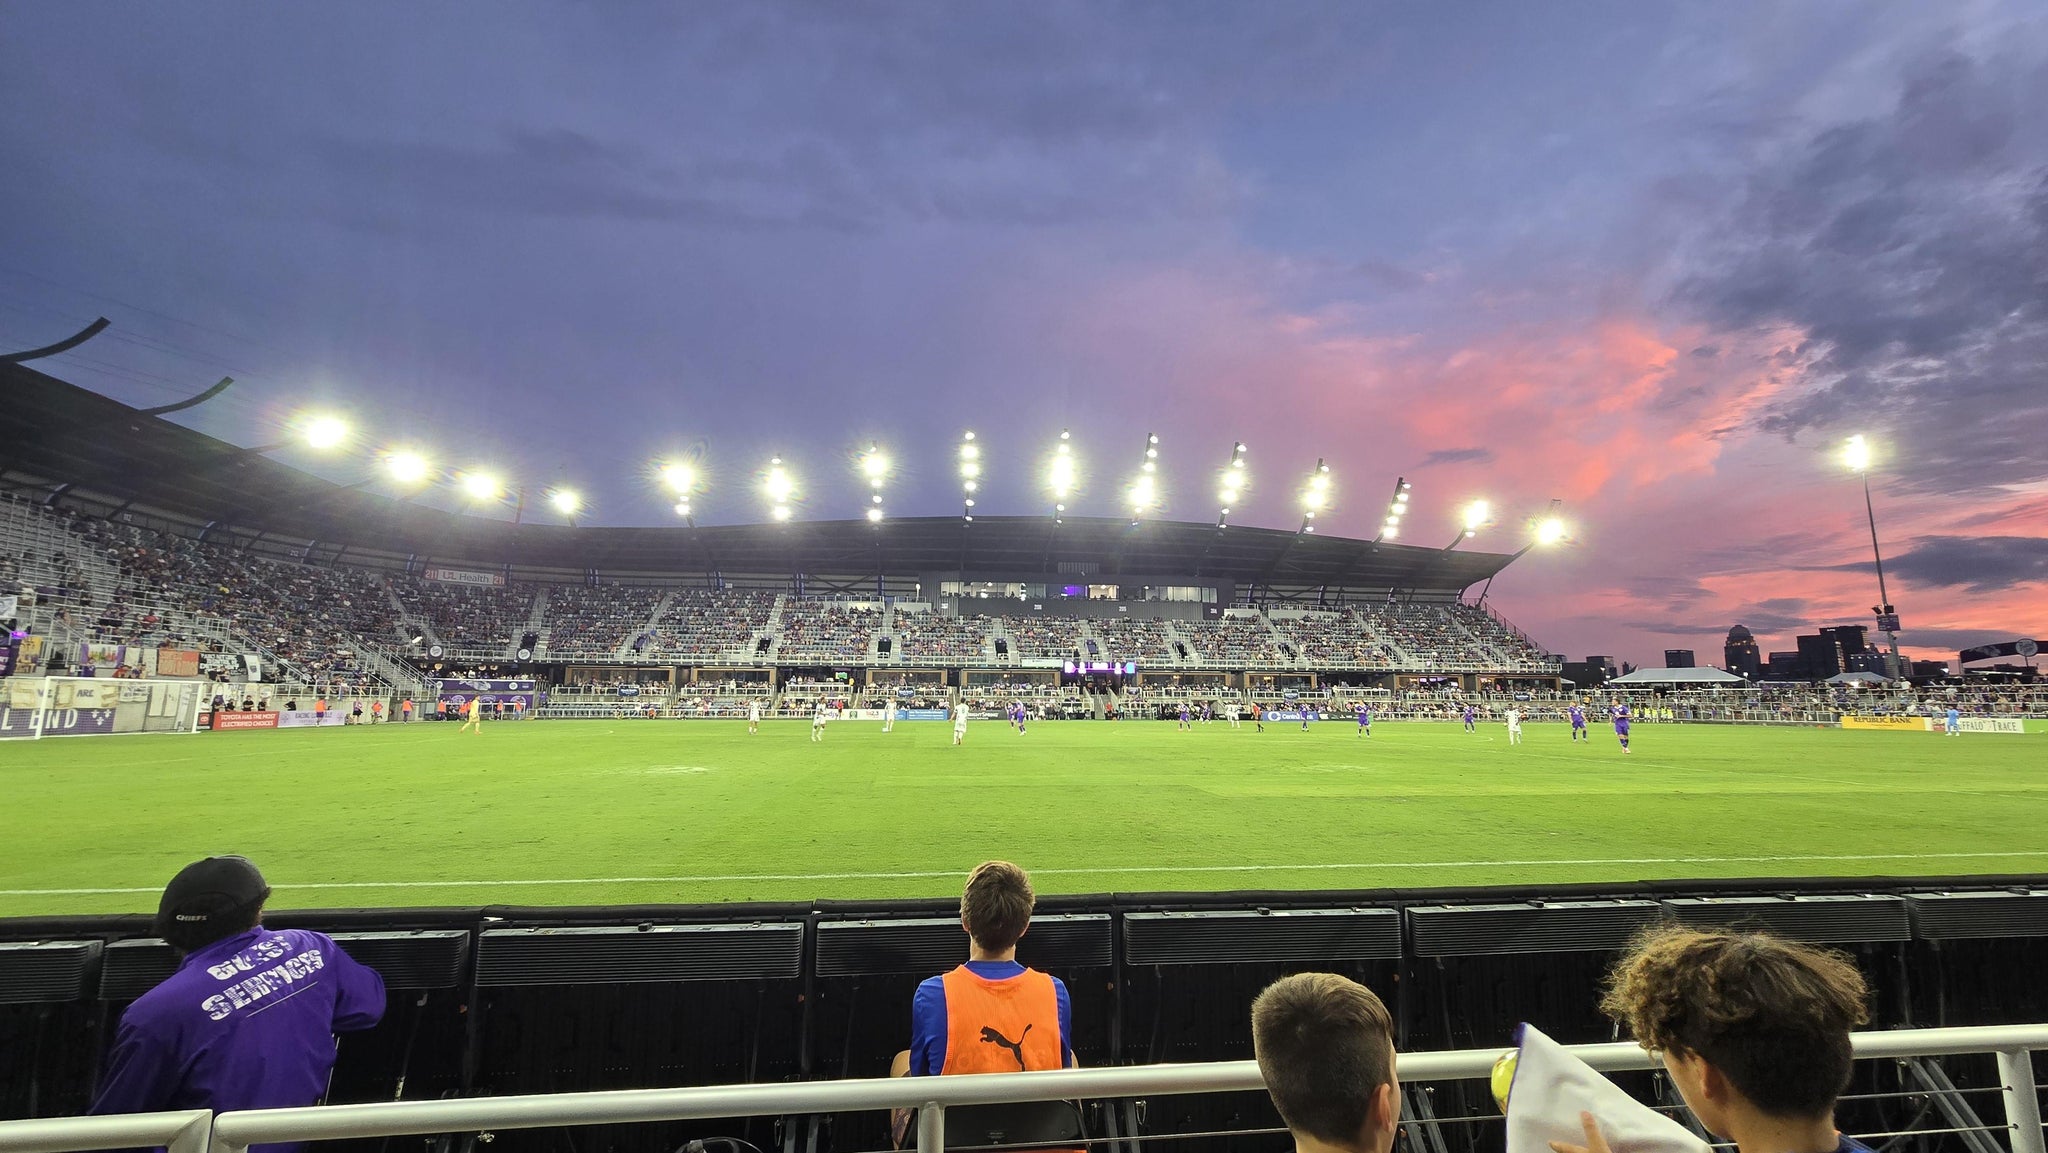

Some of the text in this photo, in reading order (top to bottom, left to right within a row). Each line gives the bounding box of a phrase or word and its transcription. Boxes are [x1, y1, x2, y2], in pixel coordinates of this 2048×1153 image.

[425, 569, 437, 579] 211
[459, 573, 489, 583] Health
[1853, 716, 1889, 724] REPUBLIC
[1992, 720, 2017, 731] TRACE
[206, 935, 293, 981] GUEST
[201, 949, 325, 1021] SERVICES
